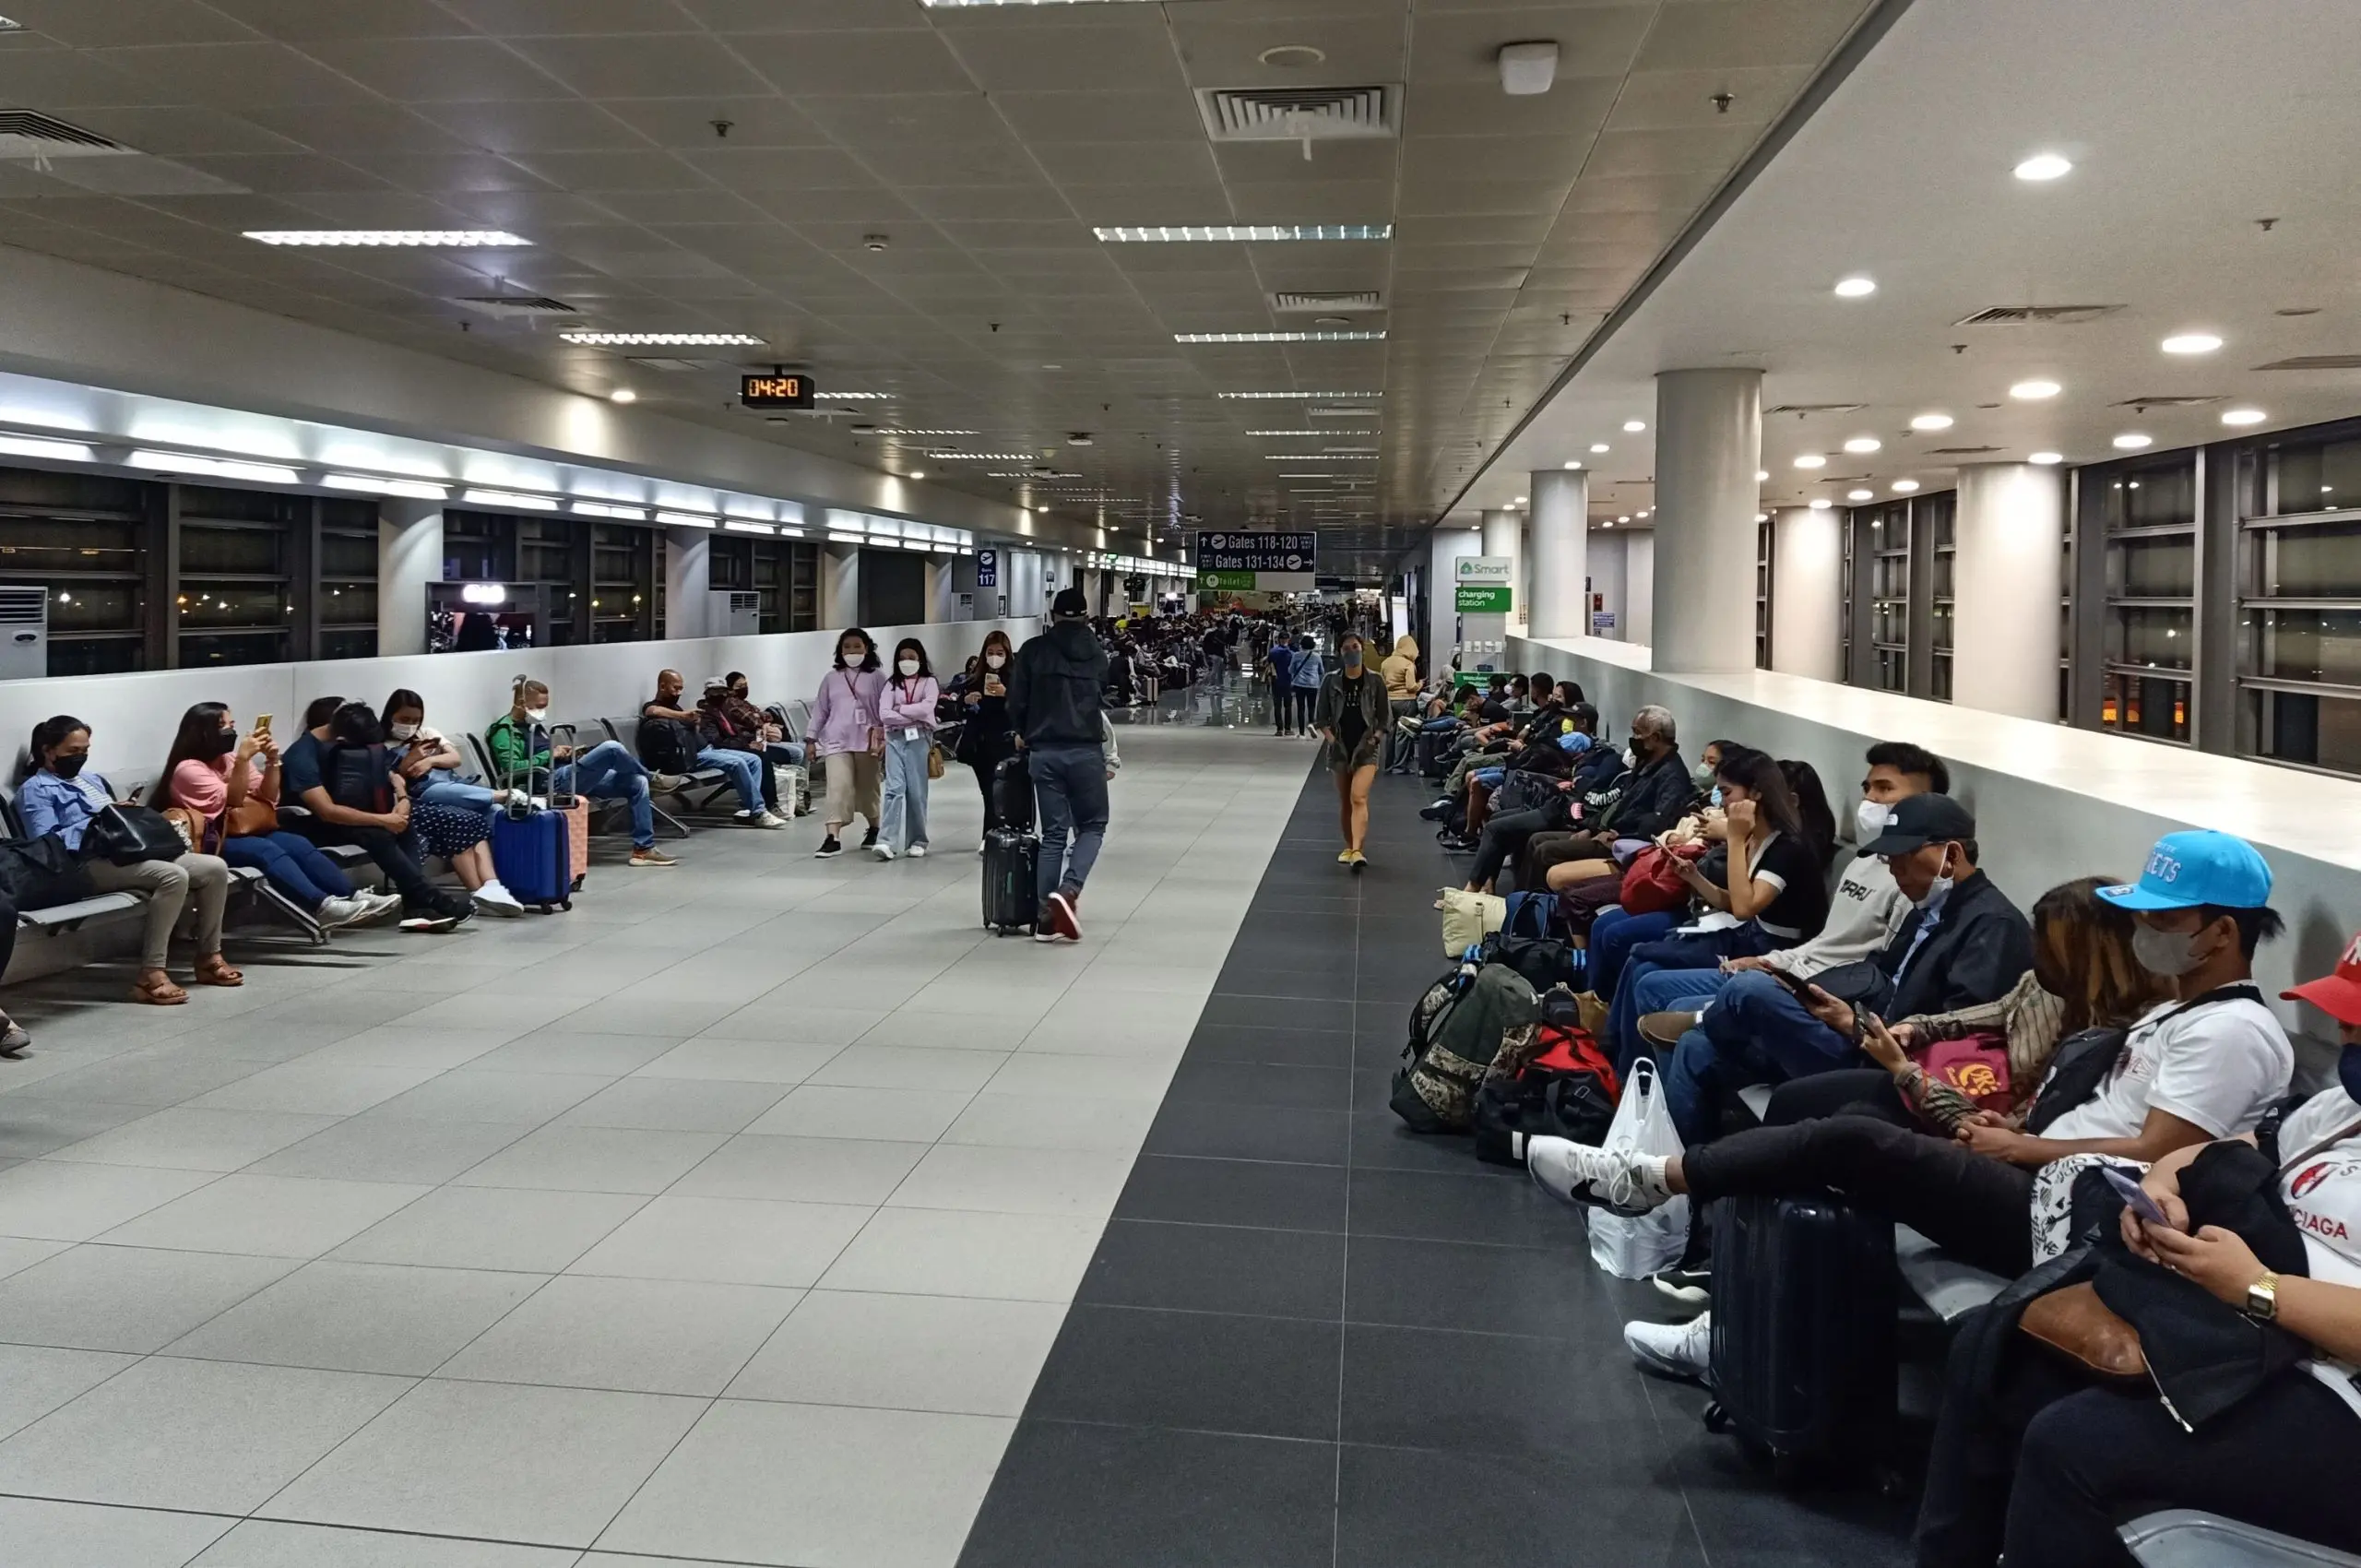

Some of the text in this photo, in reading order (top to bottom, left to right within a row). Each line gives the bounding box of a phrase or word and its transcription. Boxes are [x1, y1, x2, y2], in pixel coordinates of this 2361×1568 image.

[748, 378, 799, 398] 04:20
[1228, 535, 1255, 550] Gates
[1258, 535, 1298, 550] 118-120
[1215, 554, 1242, 569] Gates
[1245, 554, 1285, 569] 131-134
[1474, 564, 1509, 575] Smart
[979, 574, 995, 586] 117
[1458, 590, 1496, 600] charging
[1458, 599, 1485, 607] station
[2146, 850, 2182, 884] ETS
[2290, 1207, 2348, 1241] CIAGA
